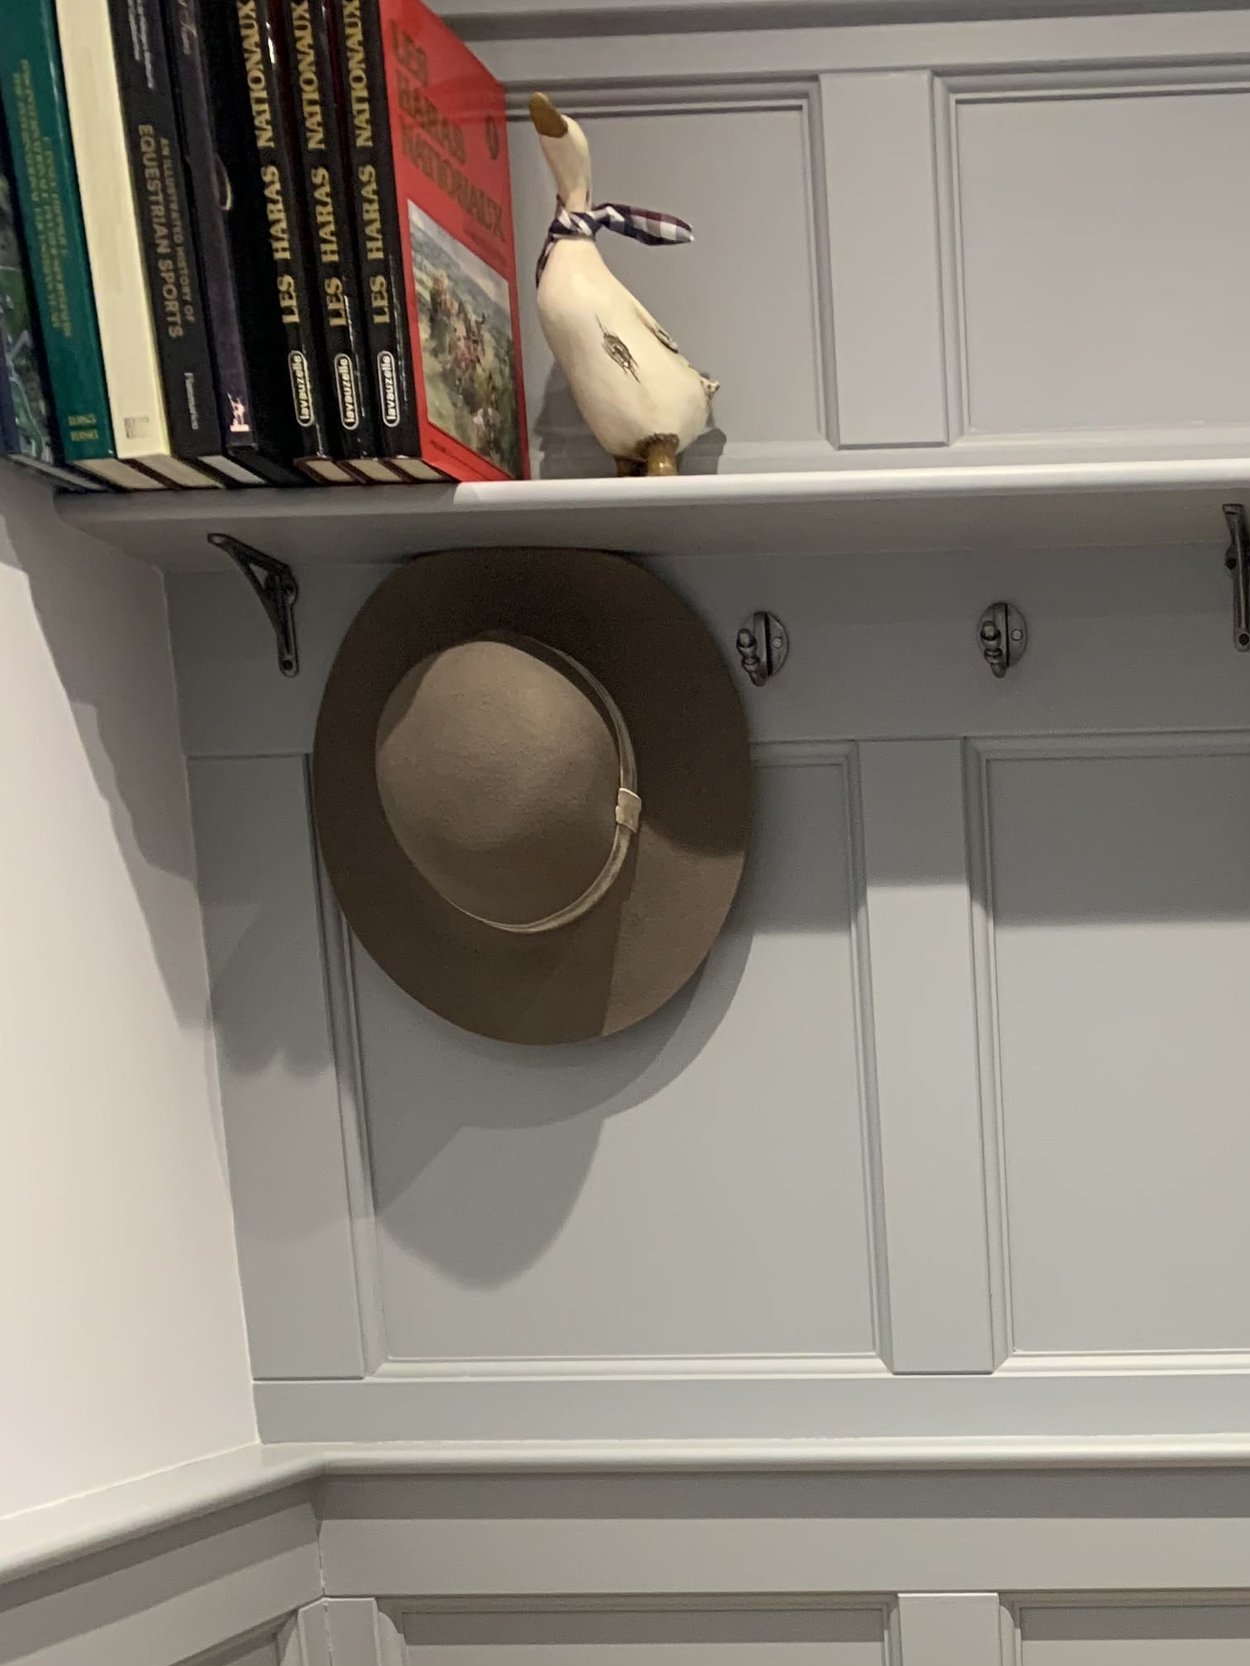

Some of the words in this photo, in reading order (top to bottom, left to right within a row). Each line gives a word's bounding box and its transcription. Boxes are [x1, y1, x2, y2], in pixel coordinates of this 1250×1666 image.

[237, 0, 275, 148] NATIONAUX
[291, 0, 325, 149] NATIONAUX
[342, 0, 373, 148] NATIONAUX
[160, 137, 170, 155] AN
[138, 124, 171, 254] EQUESTRIAN
[158, 258, 184, 339] SPORTS
[162, 158, 184, 244] ILLUSTRATED
[261, 164, 291, 260] HARAS
[311, 164, 339, 263] HARAS
[358, 164, 384, 260] HARAS
[175, 245, 192, 303] HISTORY
[277, 275, 299, 323] LES
[324, 276, 347, 326] LES
[370, 274, 391, 323] LES
[184, 305, 195, 322] OF
[292, 354, 312, 420] lavauzelle
[338, 357, 356, 424] lavauzelle
[381, 353, 398, 421] lavauzelle
